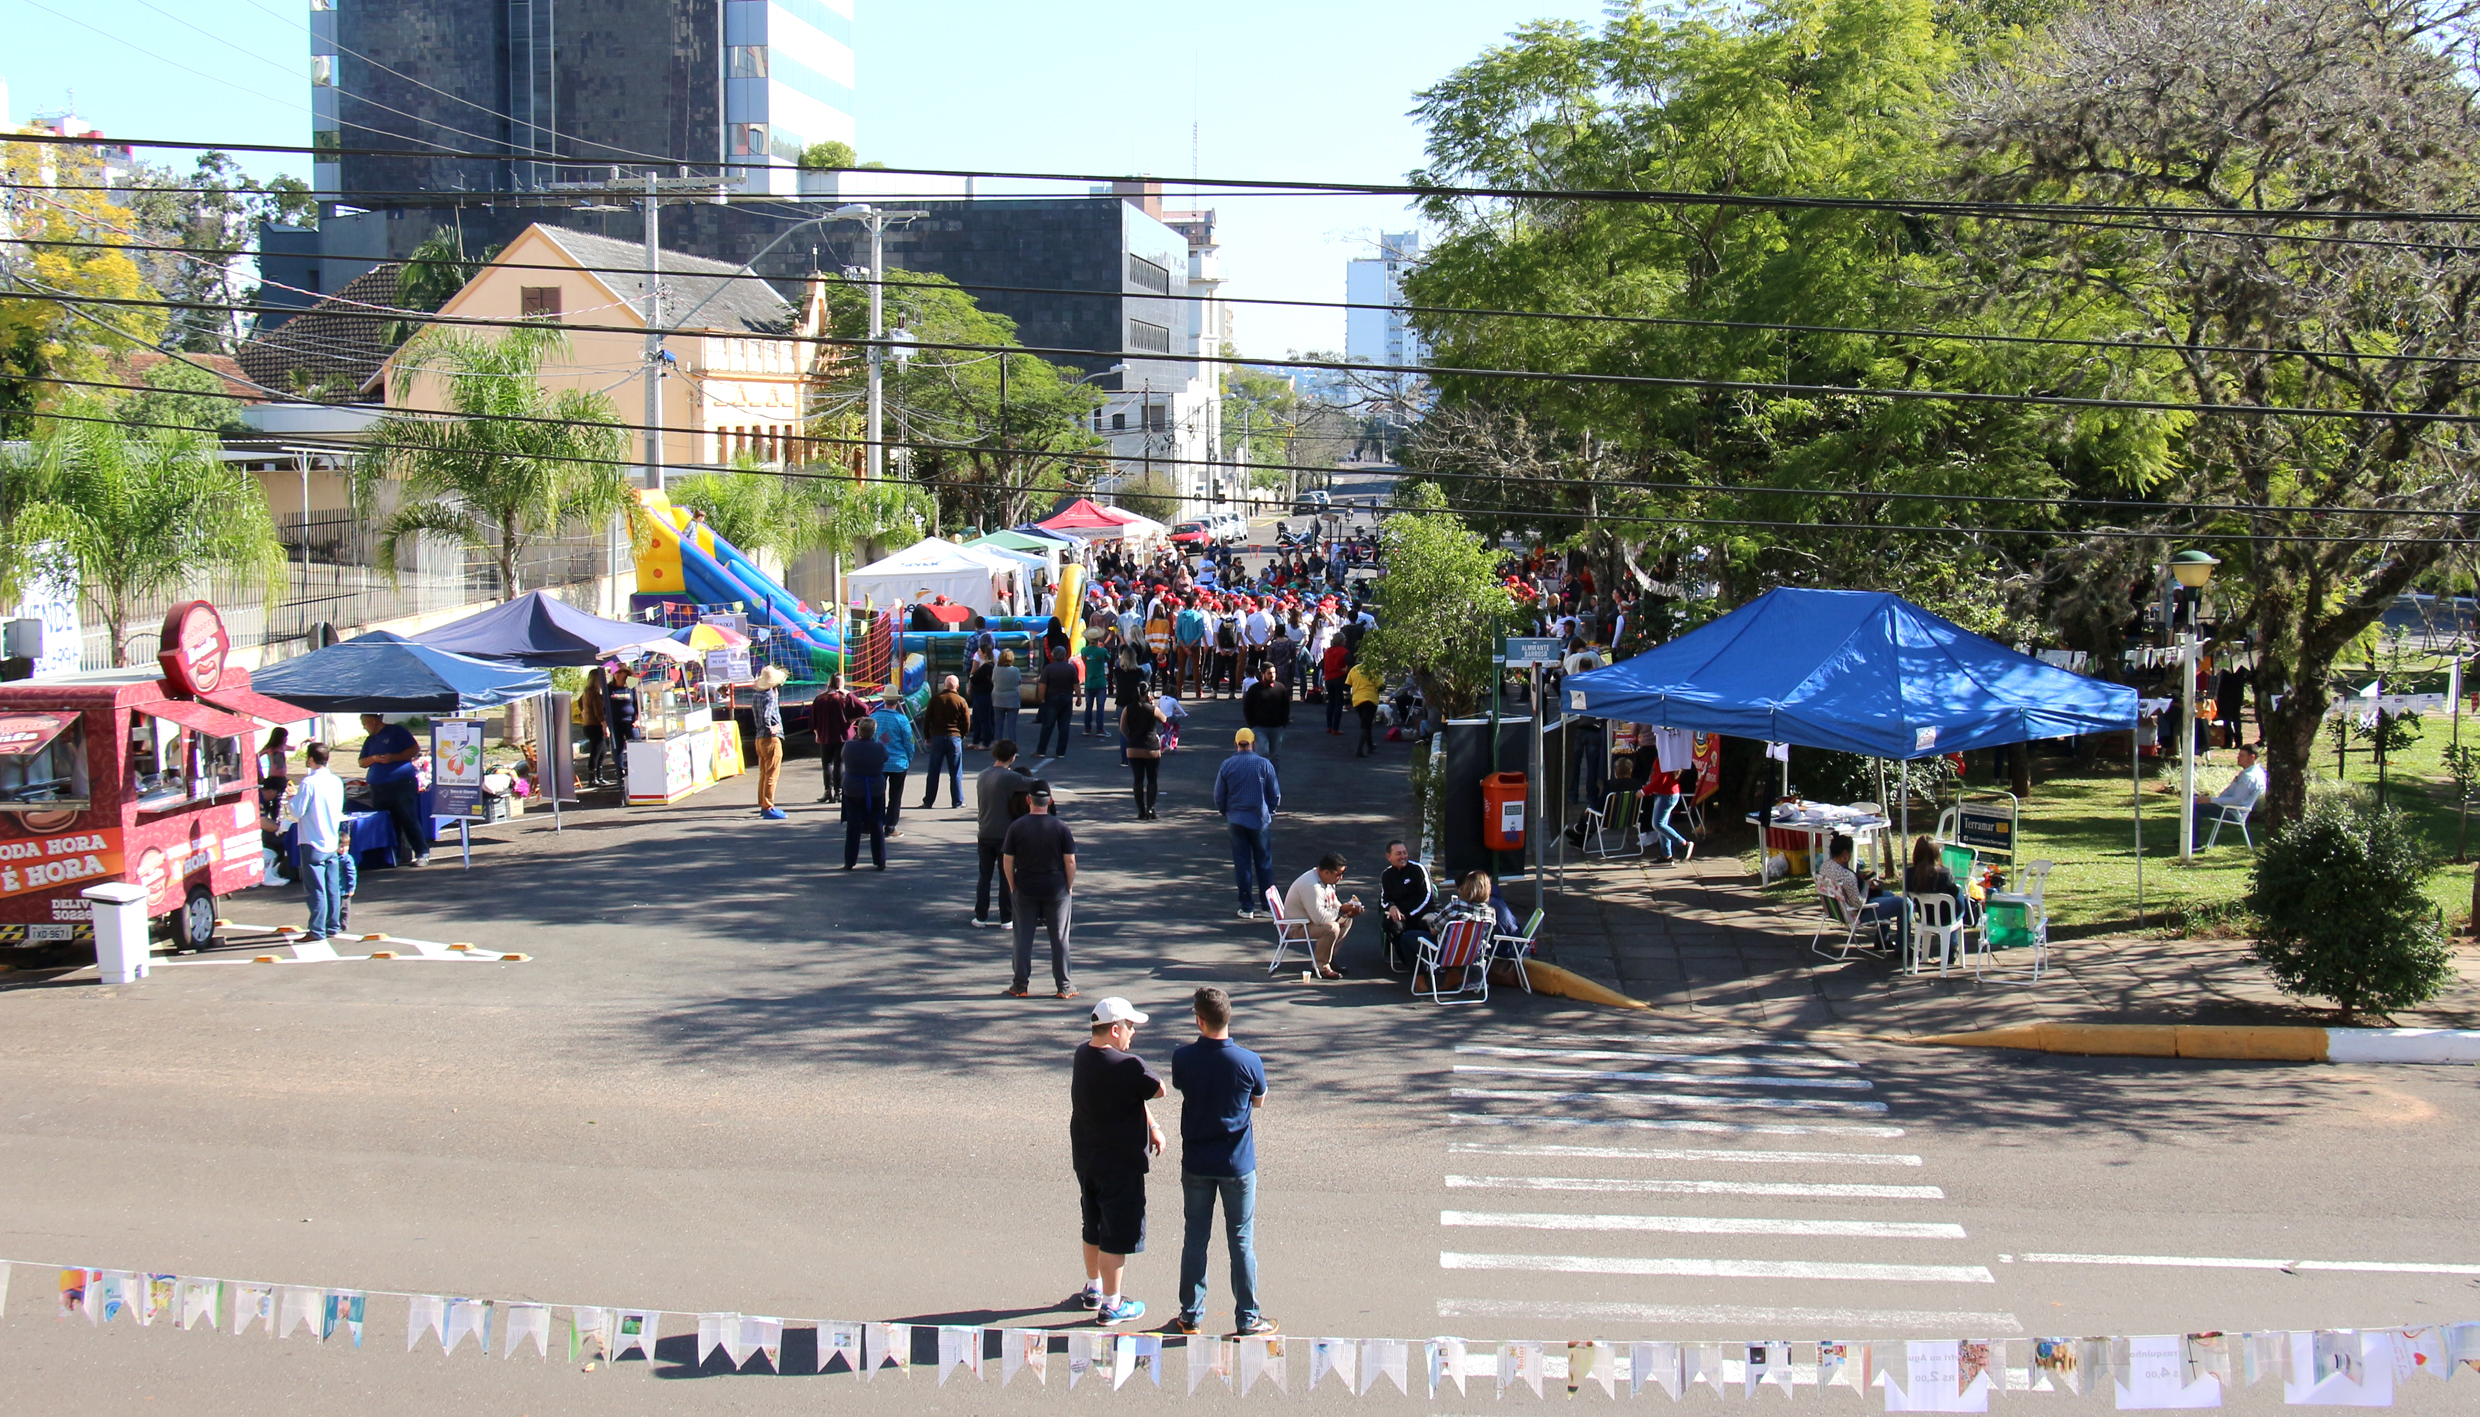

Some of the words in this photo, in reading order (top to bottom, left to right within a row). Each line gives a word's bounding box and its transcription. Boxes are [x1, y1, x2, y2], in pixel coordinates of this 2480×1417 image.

[1964, 817, 1995, 832] Terramar
[0, 842, 42, 861] ODA
[46, 834, 108, 855] HORA
[1, 865, 21, 892] É
[25, 854, 106, 887] HORA
[51, 899, 92, 909] DELIV
[1516, 1346, 1525, 1370] Solar
